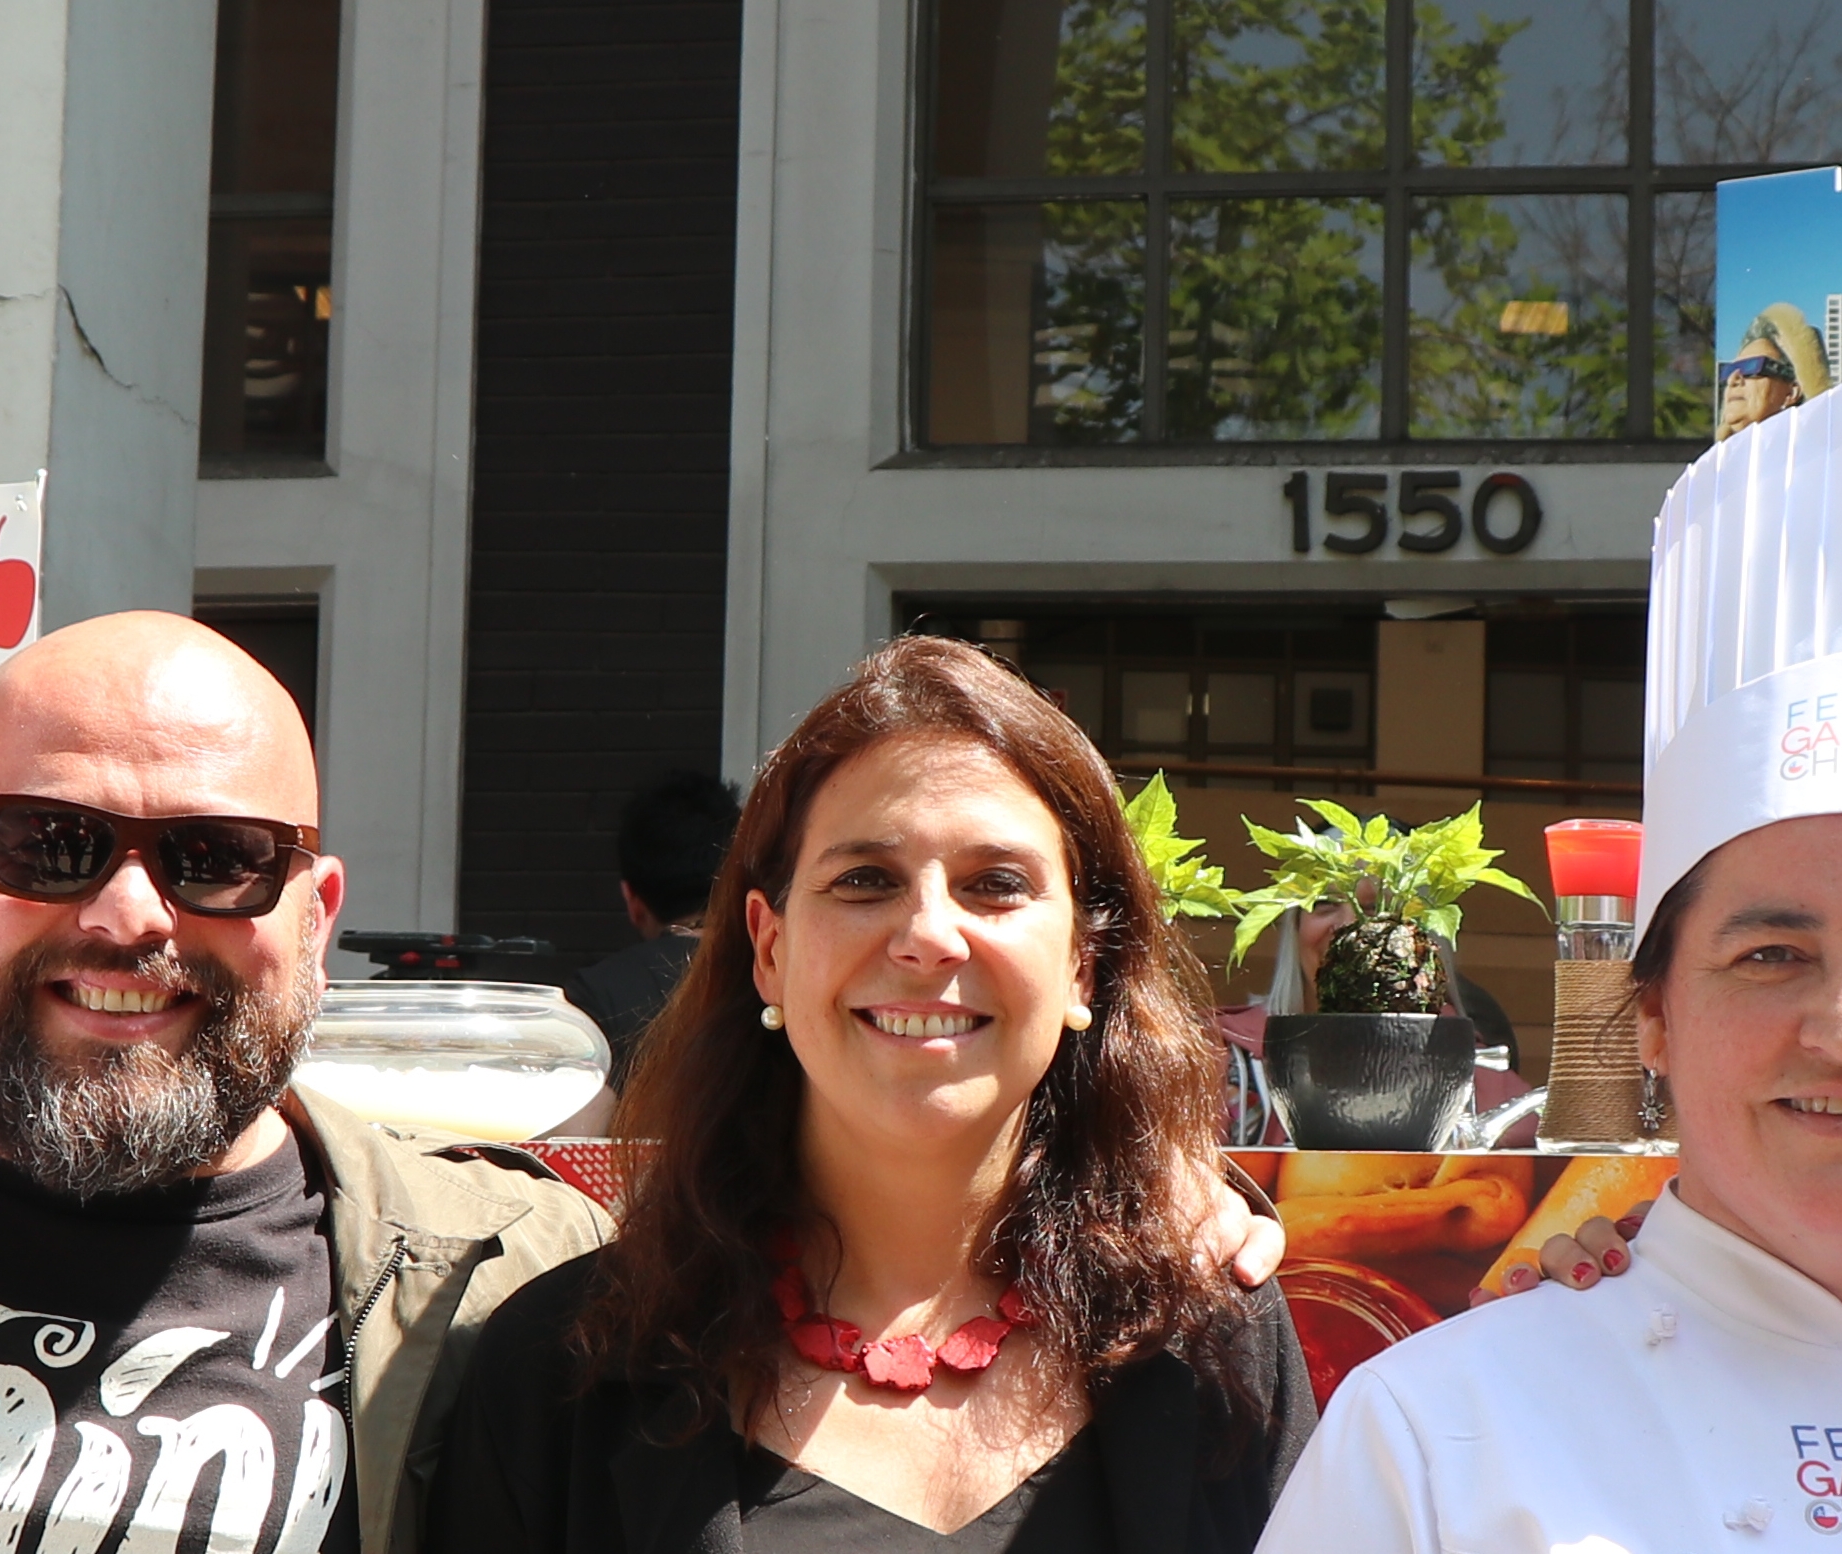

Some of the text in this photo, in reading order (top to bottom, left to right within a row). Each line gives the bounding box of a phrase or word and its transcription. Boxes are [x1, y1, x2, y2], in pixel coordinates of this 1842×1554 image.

[1282, 470, 1543, 554] 1550
[1787, 692, 1838, 729] FE
[1780, 721, 1840, 755] GA
[1779, 747, 1838, 781] CH
